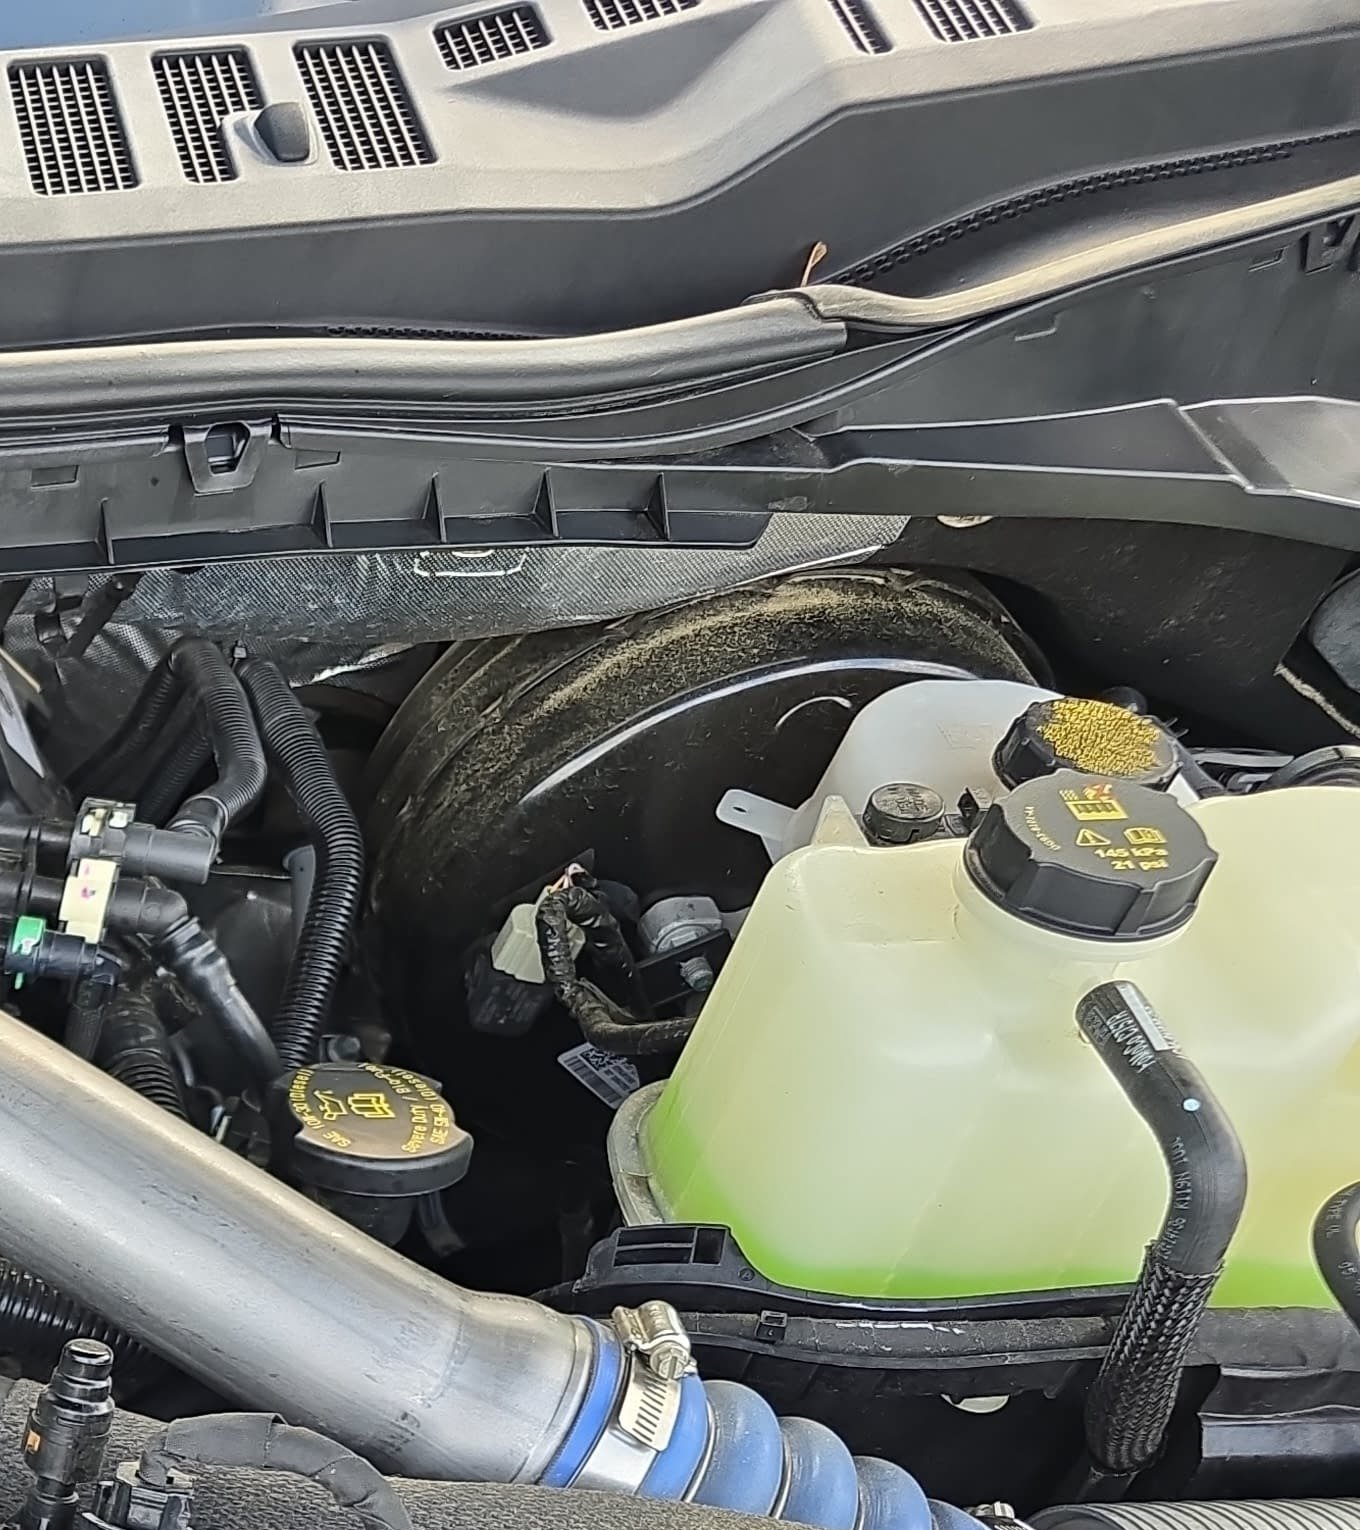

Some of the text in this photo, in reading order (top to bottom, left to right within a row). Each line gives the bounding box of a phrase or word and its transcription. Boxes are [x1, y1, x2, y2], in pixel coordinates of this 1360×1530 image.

[1094, 847, 1169, 859] 145 kPa
[1111, 860, 1135, 871] 21
